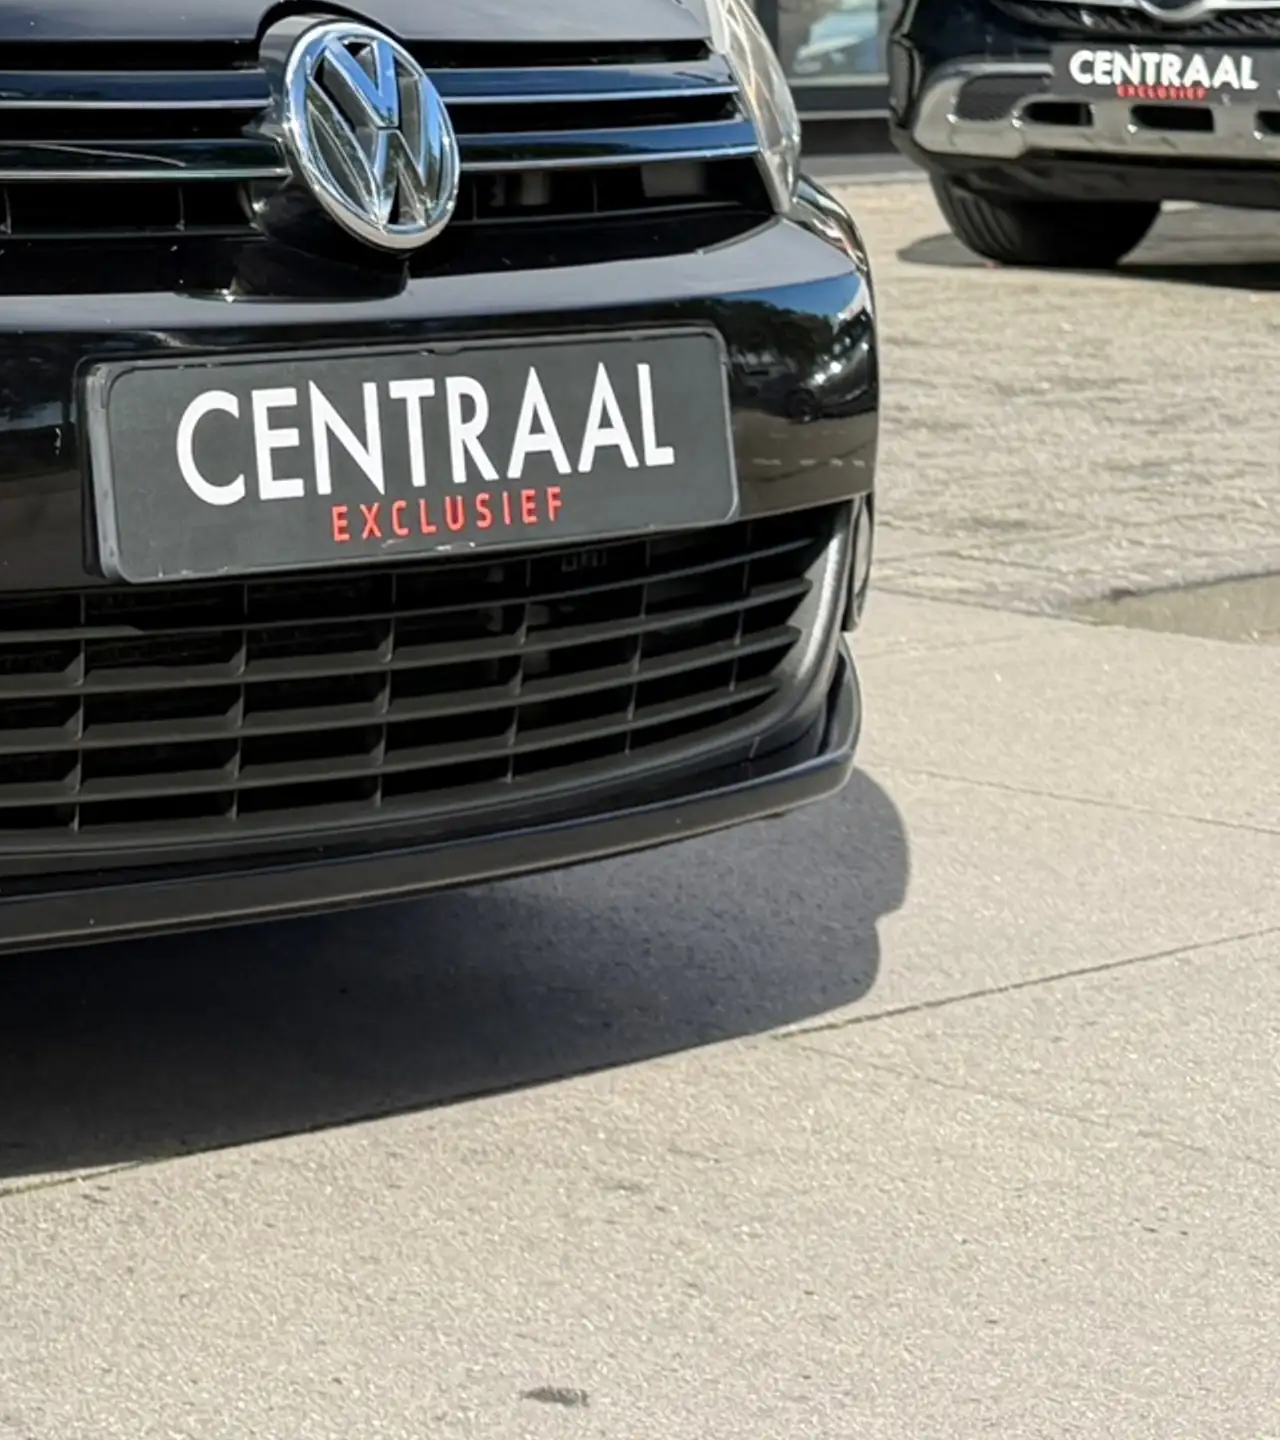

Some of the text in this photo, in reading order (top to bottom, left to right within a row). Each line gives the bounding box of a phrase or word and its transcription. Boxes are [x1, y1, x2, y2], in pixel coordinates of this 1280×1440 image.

[1069, 49, 1260, 90] CENTRAAL
[175, 360, 676, 507] CENTRAAL
[332, 485, 563, 543] EXCLUSIEF
